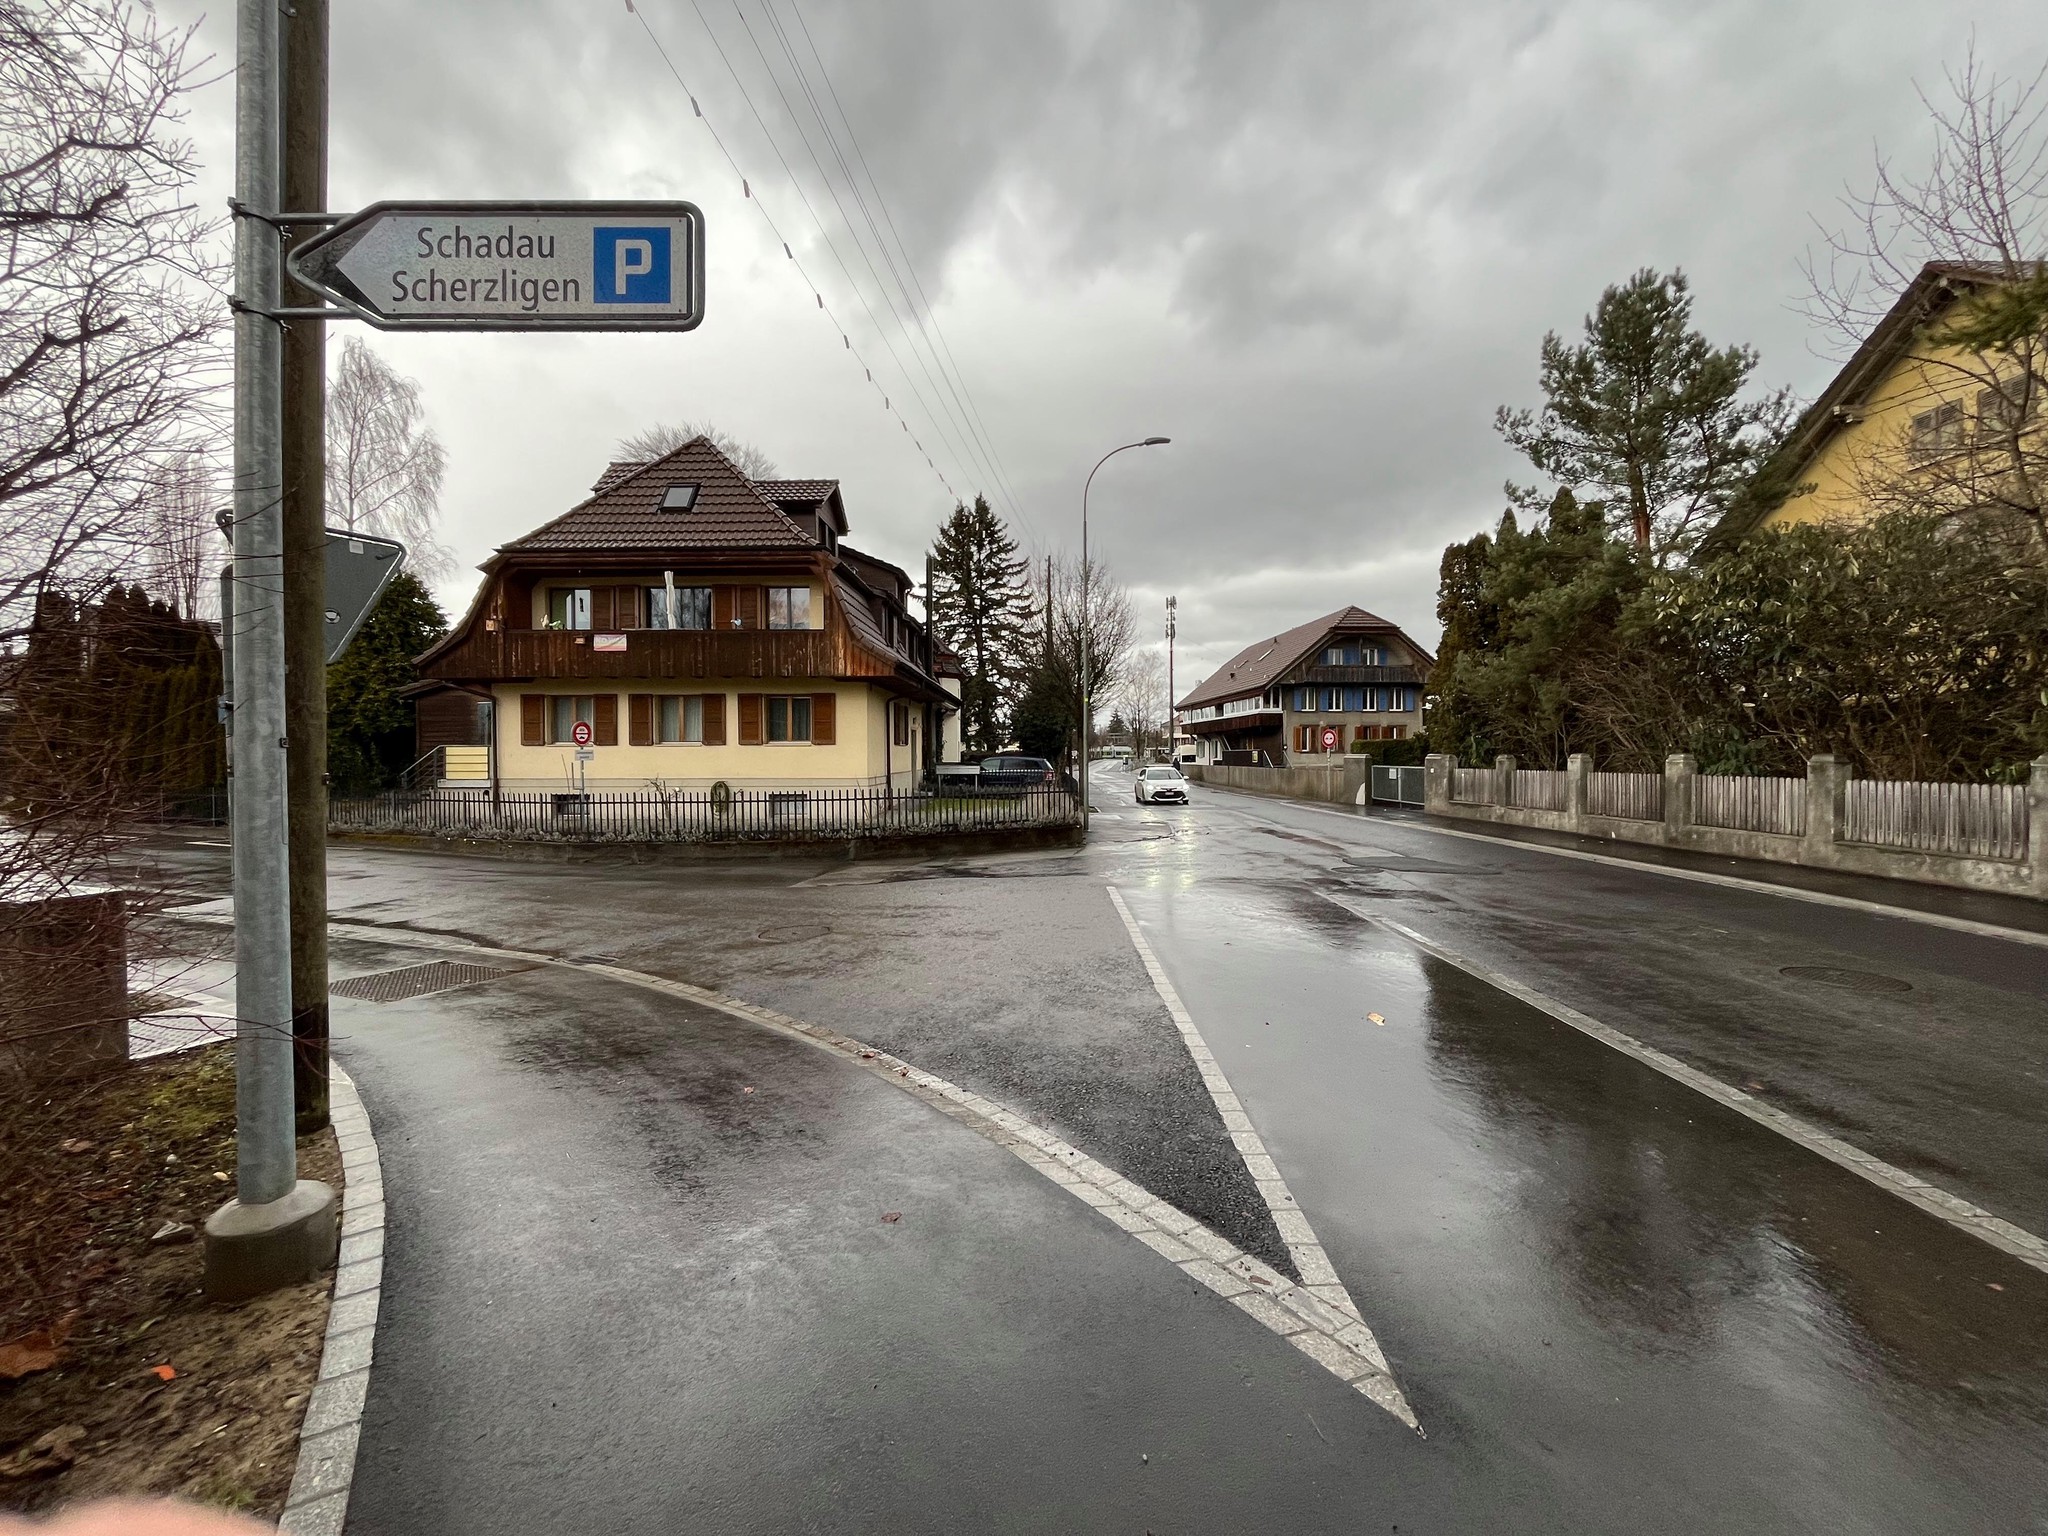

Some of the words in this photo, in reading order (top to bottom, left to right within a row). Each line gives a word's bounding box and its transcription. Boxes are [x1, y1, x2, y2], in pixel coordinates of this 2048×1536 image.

[417, 226, 555, 258] Schadau
[615, 239, 652, 295] P
[392, 268, 580, 310] Scherzligen
